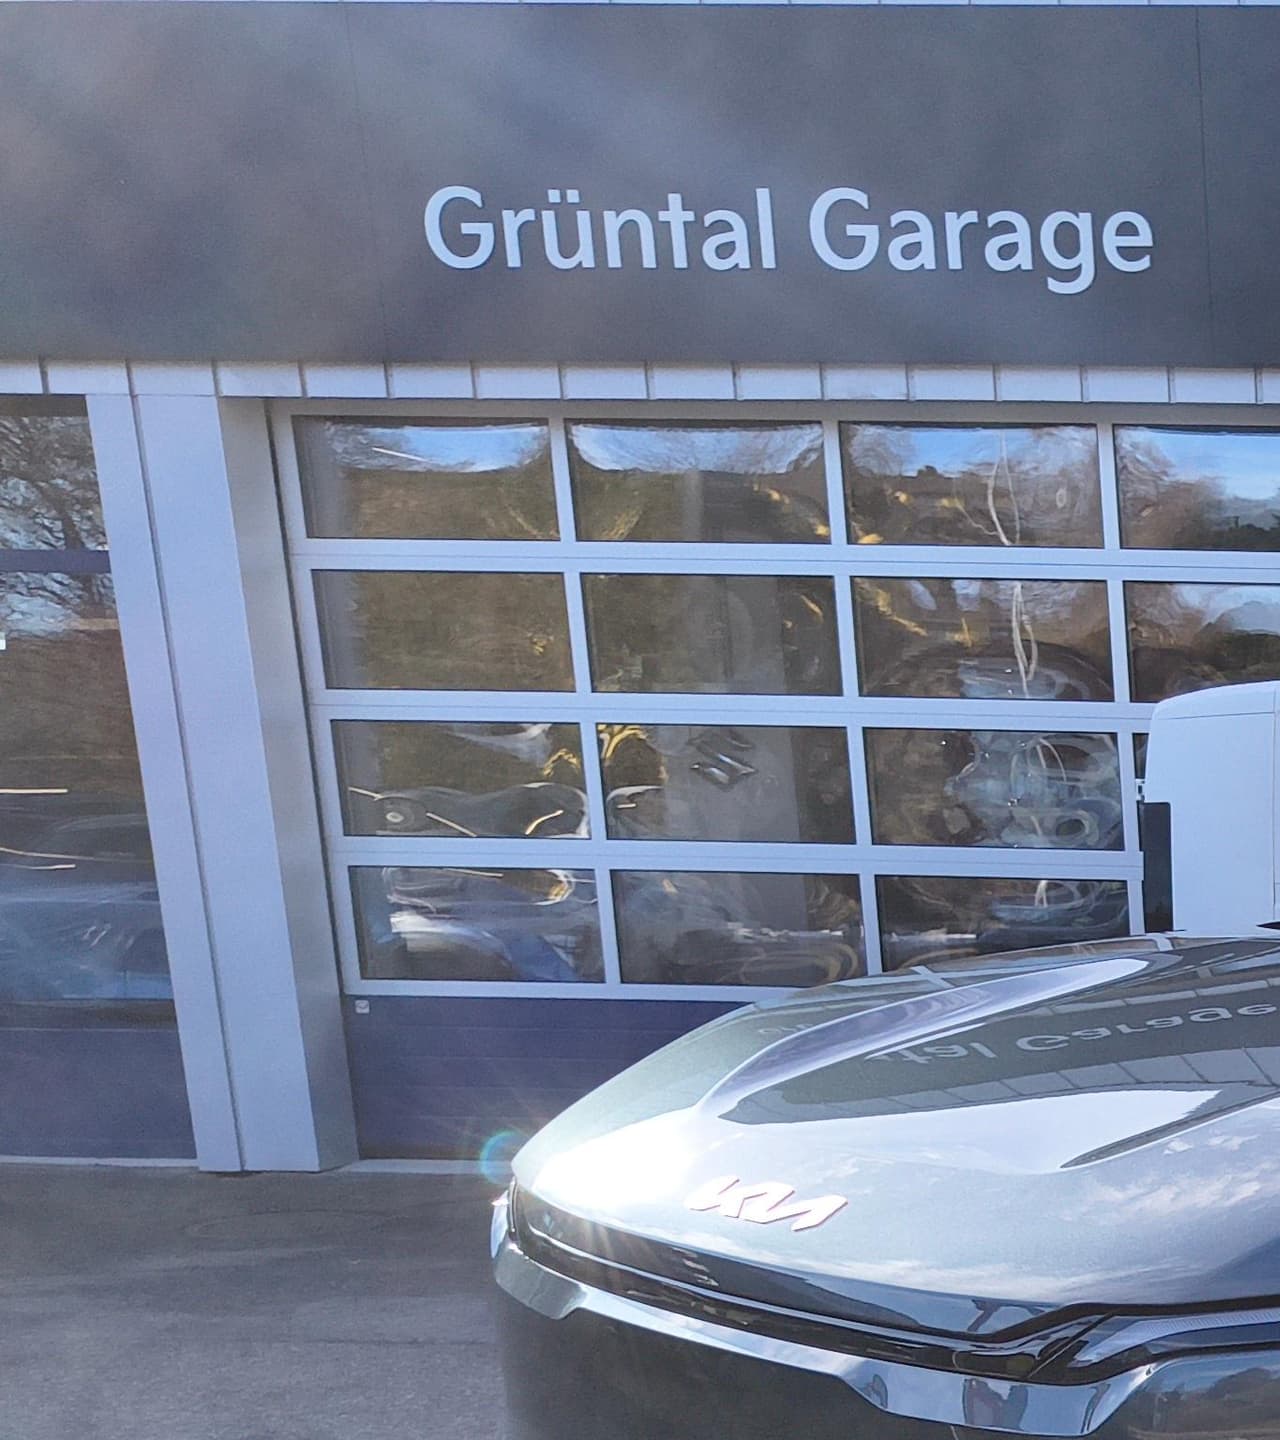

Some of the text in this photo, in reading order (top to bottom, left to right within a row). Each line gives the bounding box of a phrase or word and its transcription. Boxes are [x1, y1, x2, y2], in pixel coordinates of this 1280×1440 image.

[423, 185, 1154, 295] Grüntal Garage
[685, 1174, 849, 1233] KIA
